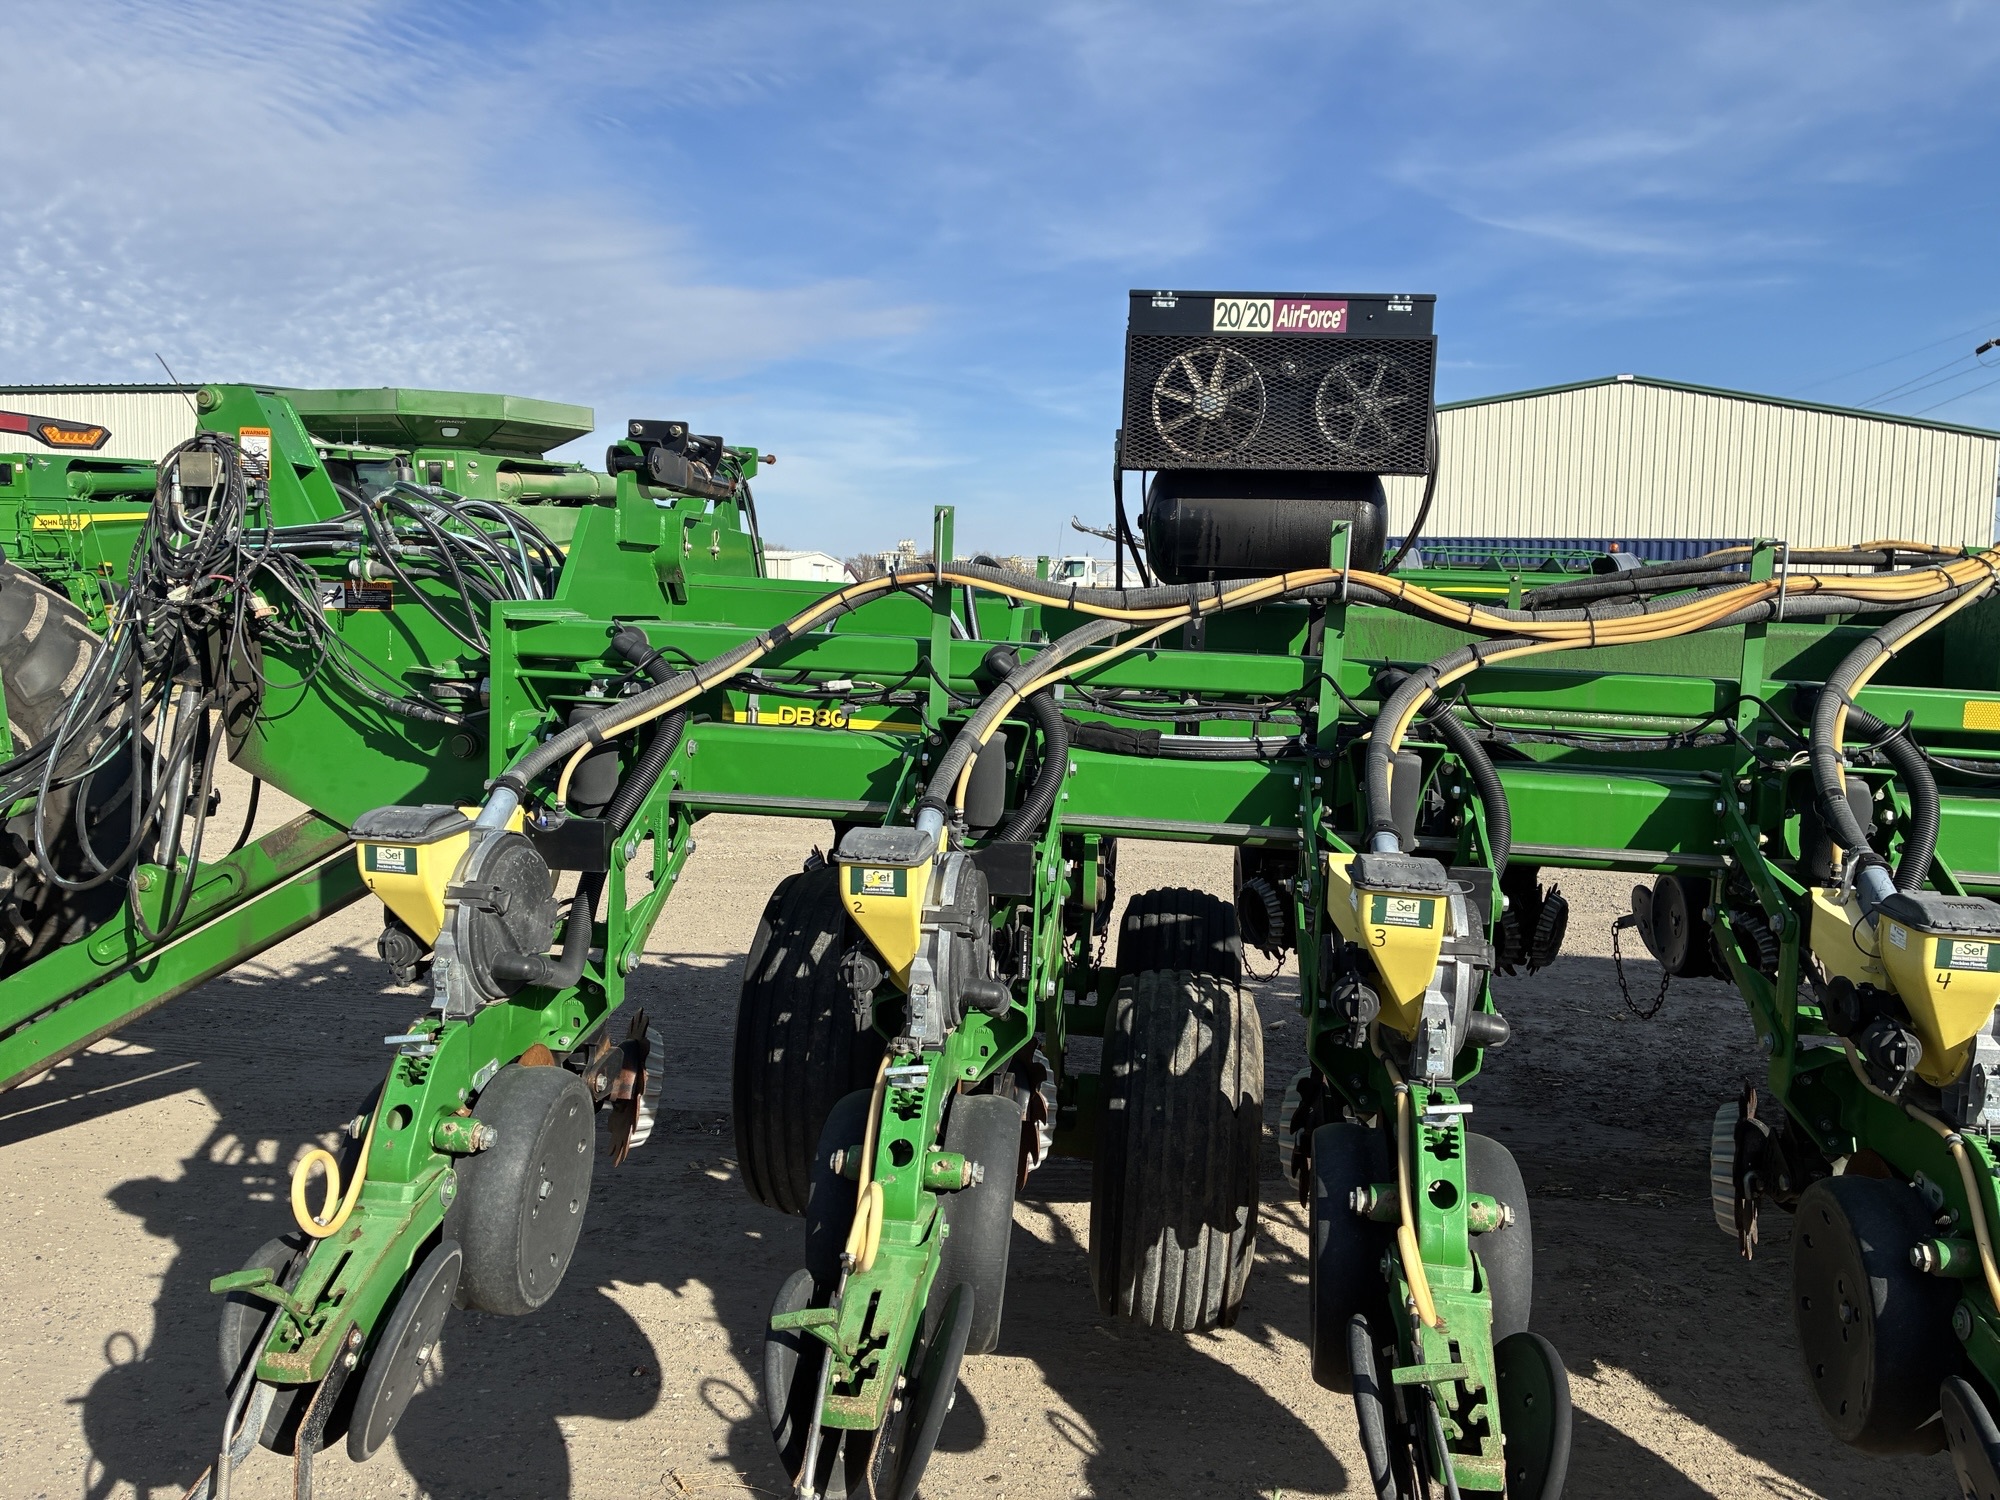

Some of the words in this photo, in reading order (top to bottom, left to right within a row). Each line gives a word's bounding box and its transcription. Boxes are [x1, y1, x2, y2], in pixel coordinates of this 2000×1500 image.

[1216, 301, 1271, 329] 20/20
[778, 706, 847, 728] DB80
[379, 849, 403, 860] eSet
[368, 878, 376, 889] 1
[853, 901, 866, 913] 2
[1389, 900, 1417, 912] eSet
[1372, 929, 1386, 947] 3
[1955, 944, 1985, 956] eSet
[1936, 972, 1951, 990] 4
